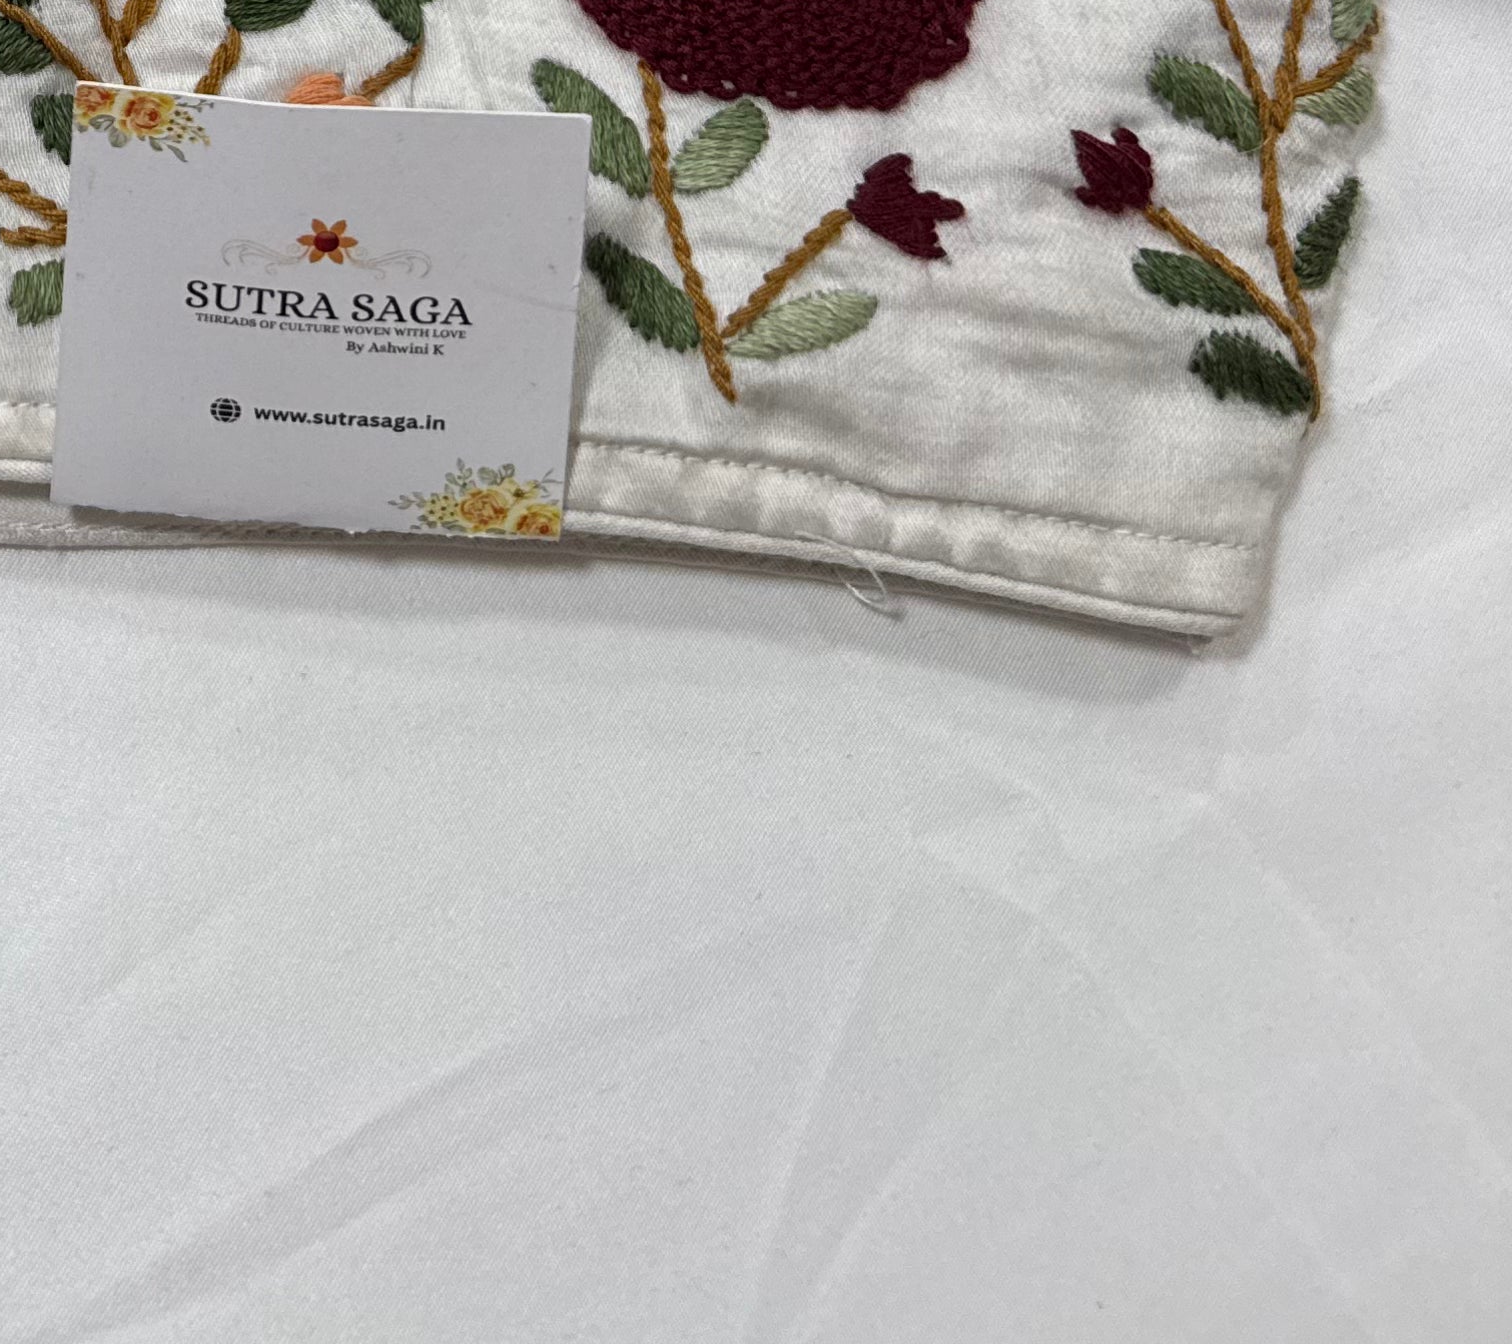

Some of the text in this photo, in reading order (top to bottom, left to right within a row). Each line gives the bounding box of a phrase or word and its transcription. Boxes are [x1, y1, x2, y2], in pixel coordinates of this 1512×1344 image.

[185, 279, 473, 326] SUTRA SAGA
[195, 312, 467, 339] THREADS OF CULTURE WOVEN WITH LOVE
[346, 340, 445, 356] By Ashwini K
[253, 407, 446, 433] www.sutrasaga.in
